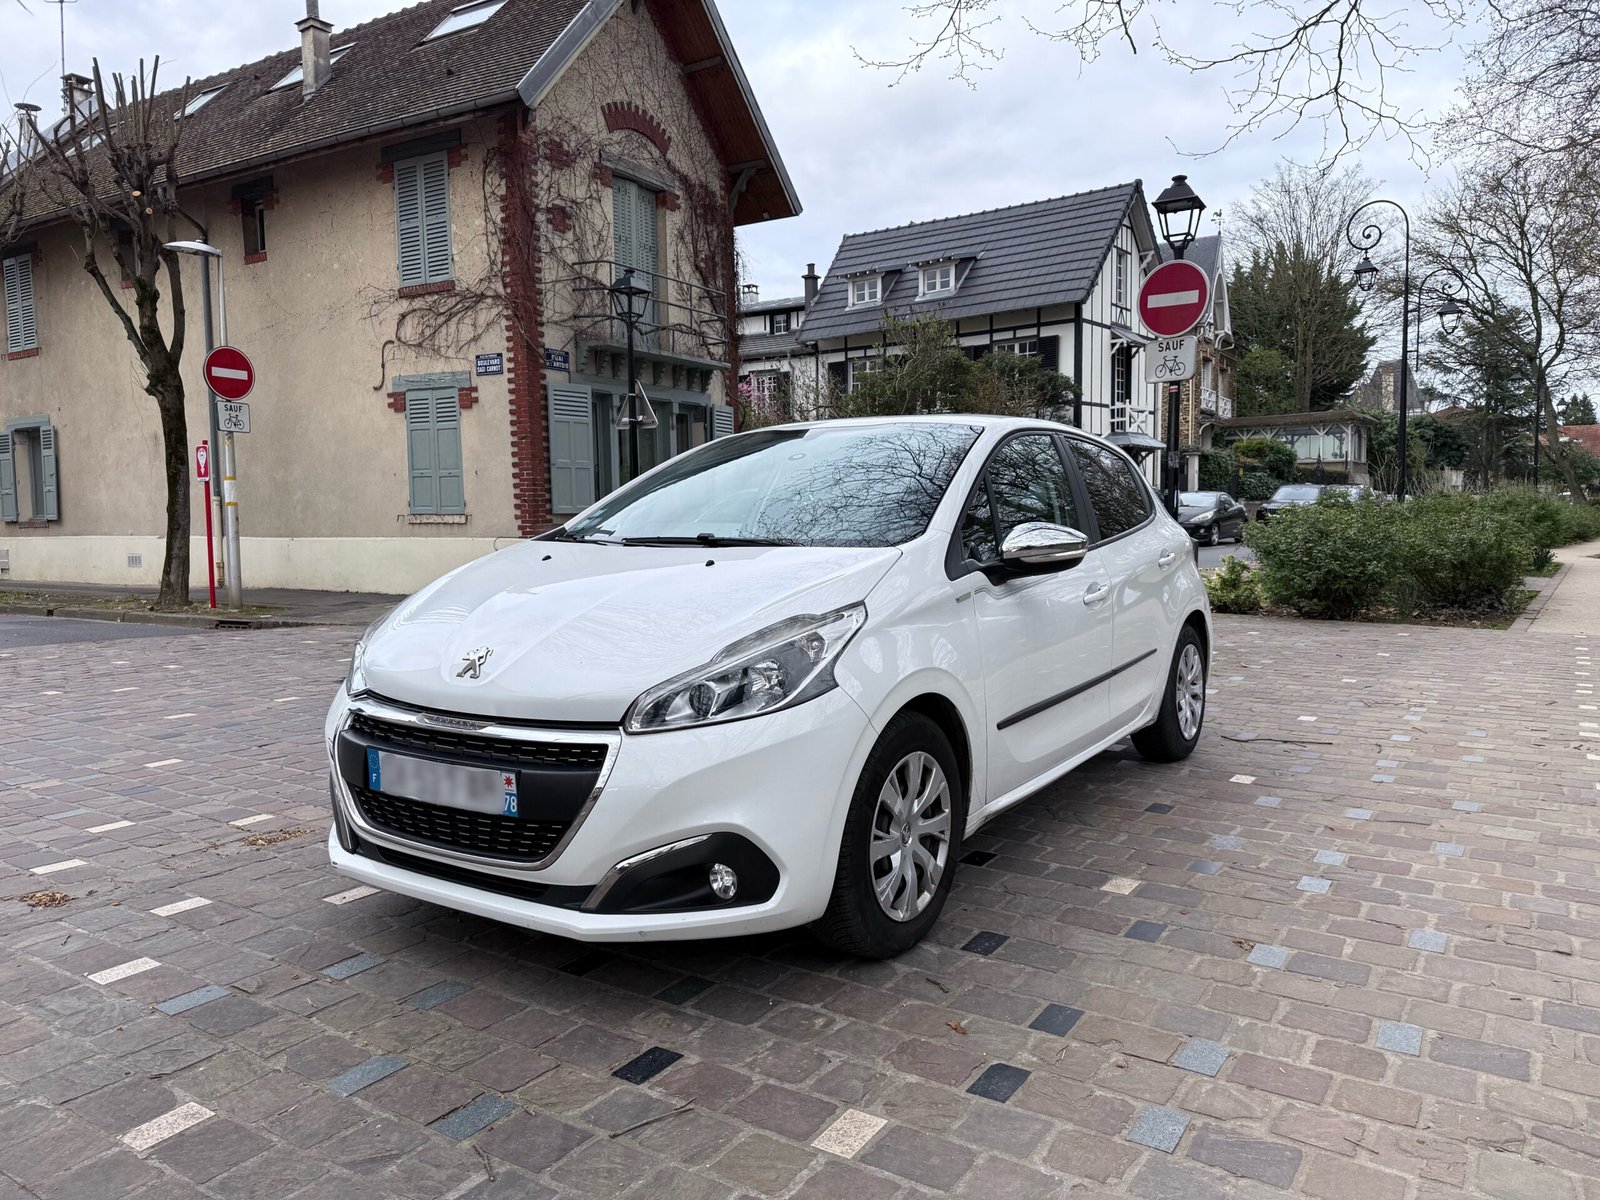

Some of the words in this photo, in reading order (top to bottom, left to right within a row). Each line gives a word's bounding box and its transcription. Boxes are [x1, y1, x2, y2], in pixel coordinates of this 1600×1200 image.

[1158, 340, 1184, 352] SAUF
[477, 359, 500, 367] BOULEVARD
[224, 404, 242, 413] SAUF
[372, 773, 377, 782] F
[504, 795, 517, 812] 78
